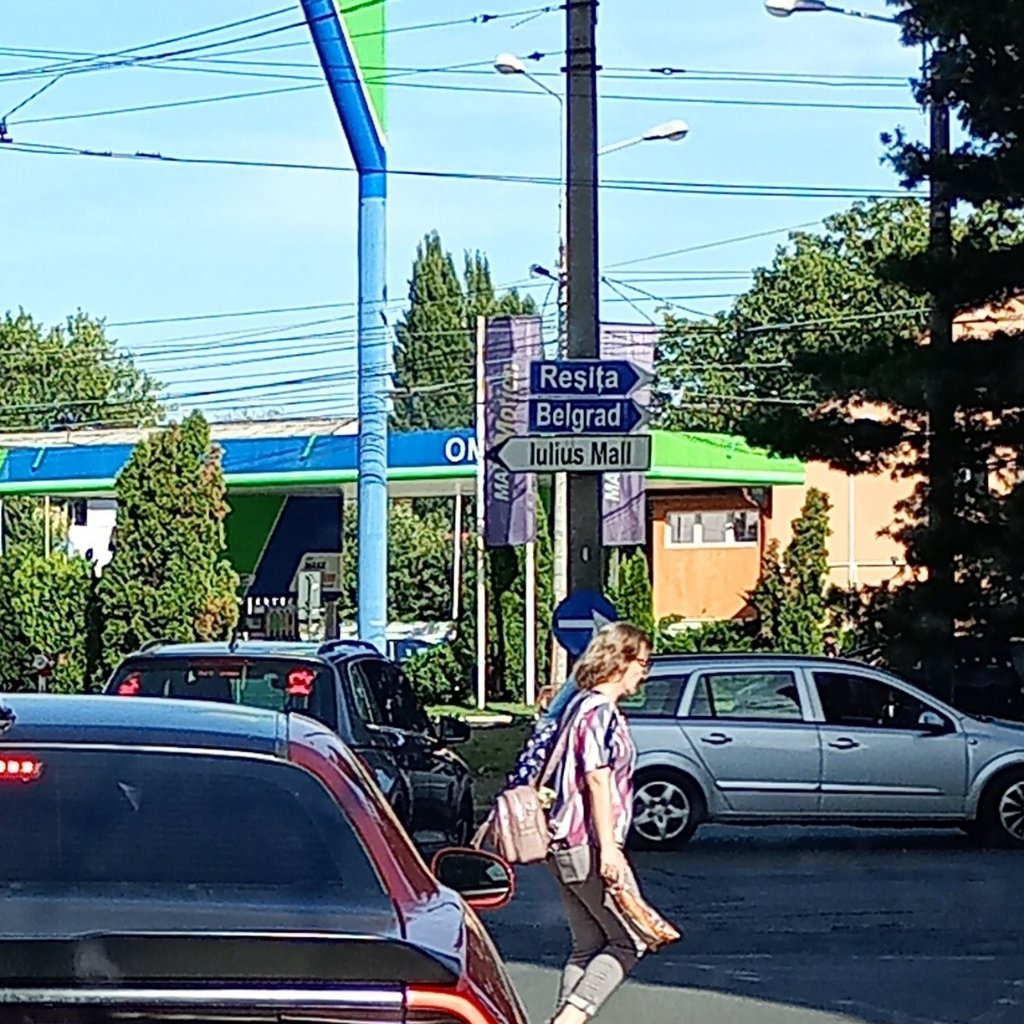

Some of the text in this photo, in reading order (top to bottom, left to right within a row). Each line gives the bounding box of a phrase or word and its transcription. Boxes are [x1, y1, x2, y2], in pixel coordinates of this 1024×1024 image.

[536, 402, 621, 433] Belgrad
[530, 441, 632, 466] Iulius Mall
